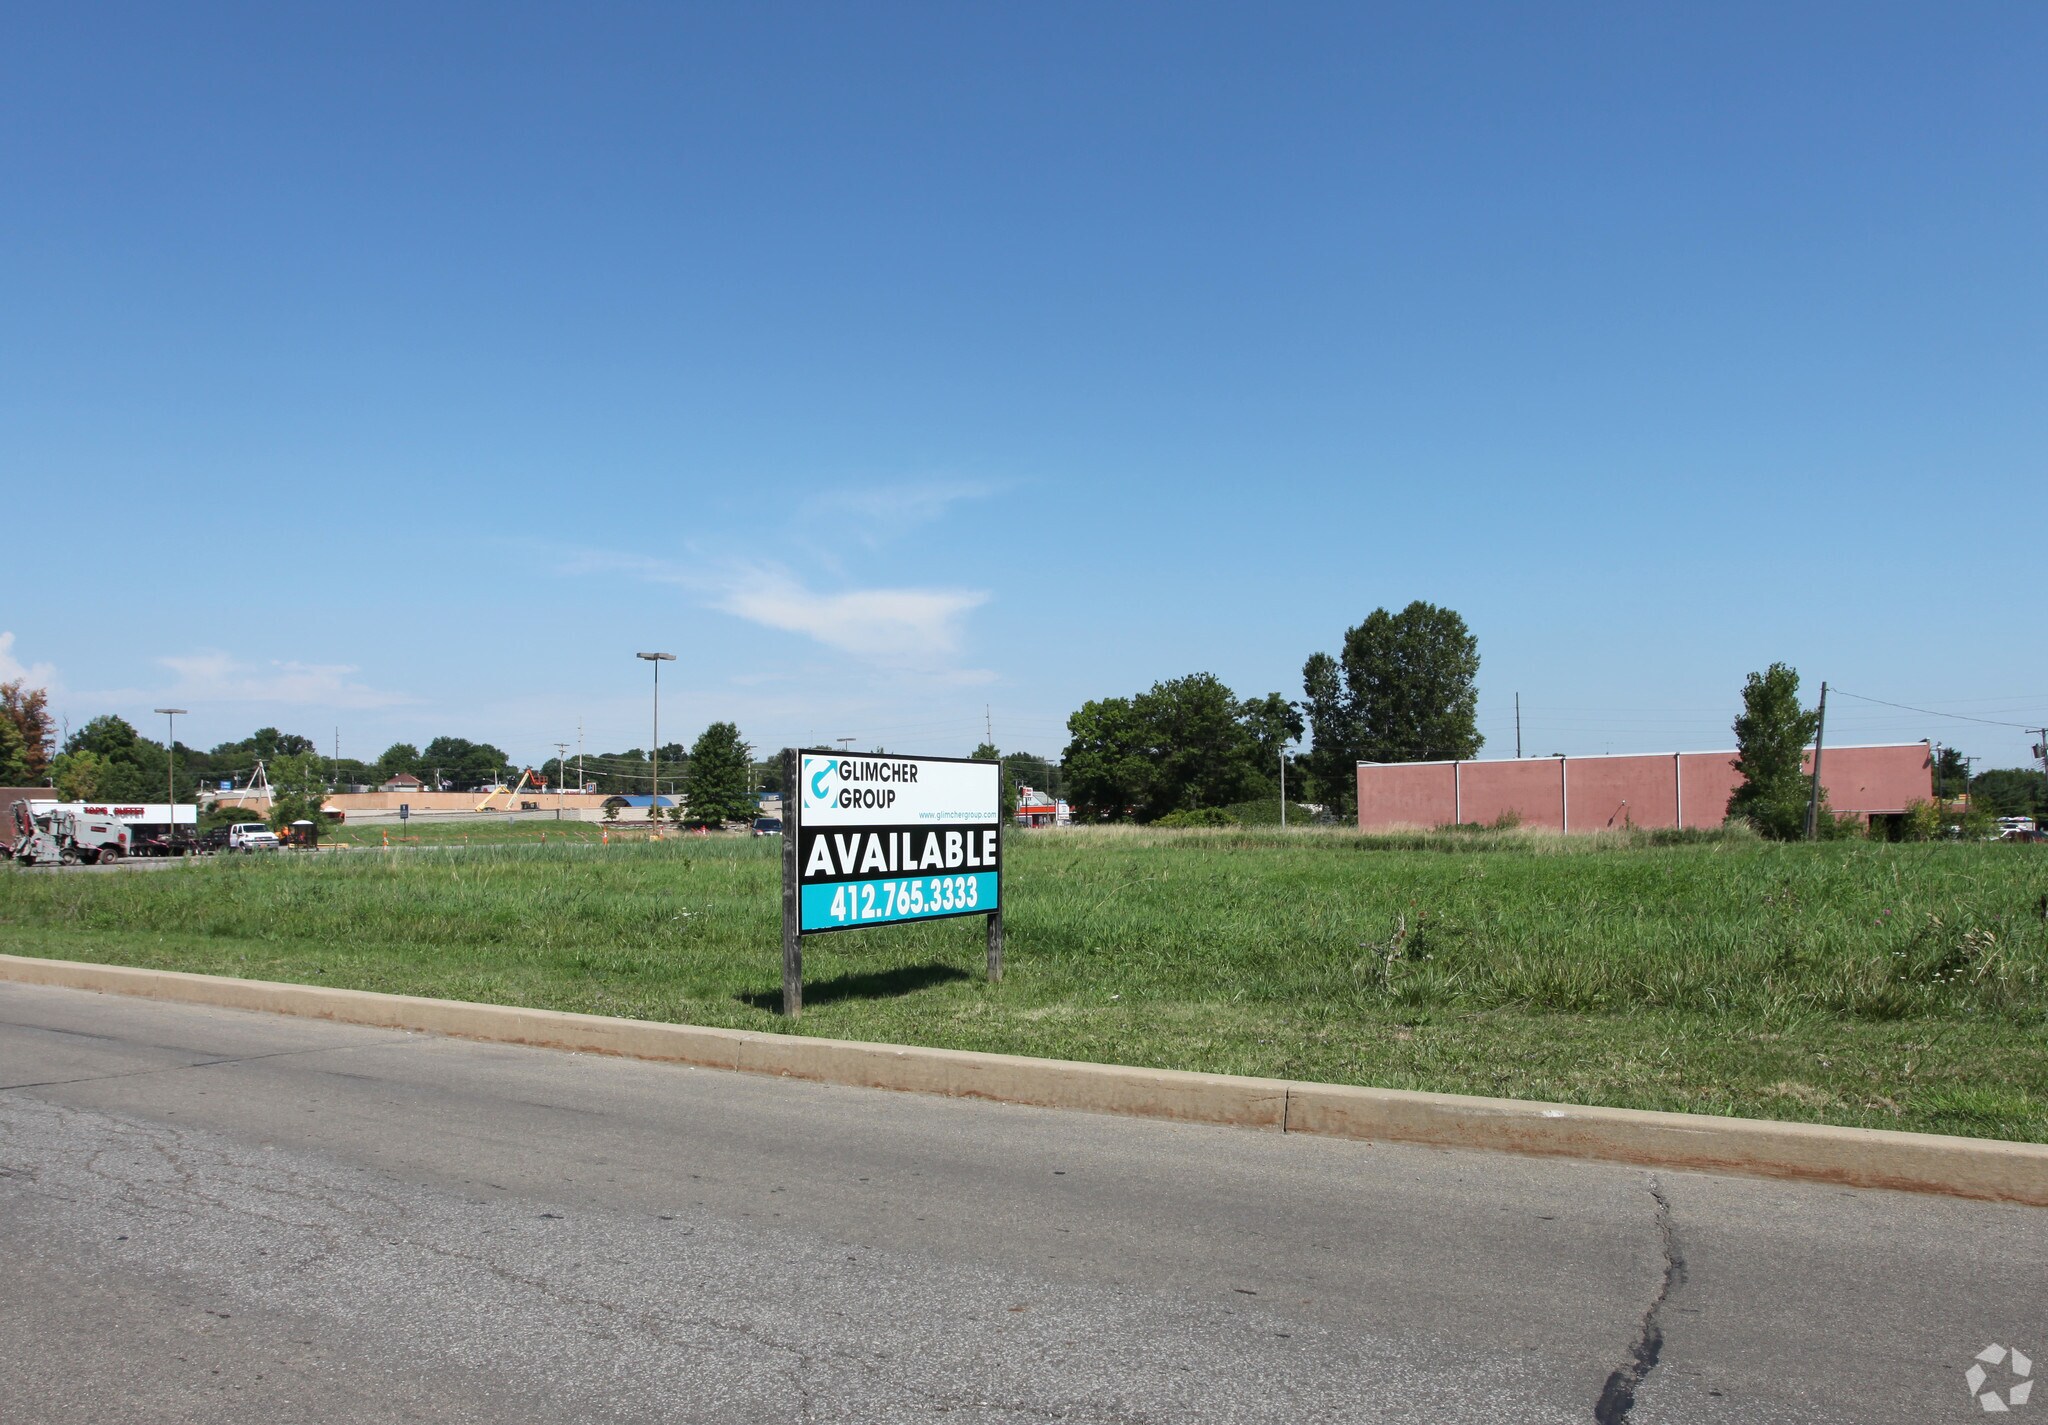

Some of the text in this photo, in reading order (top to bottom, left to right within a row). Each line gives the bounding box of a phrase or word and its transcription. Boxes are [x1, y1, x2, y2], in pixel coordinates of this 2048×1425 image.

[839, 760, 918, 783] GLIMCHER
[839, 788, 896, 809] GROUP
[918, 810, 997, 821] www.glimchergroup.com
[804, 830, 997, 877] AVAILABLE
[830, 875, 978, 922] 412.765.3333
